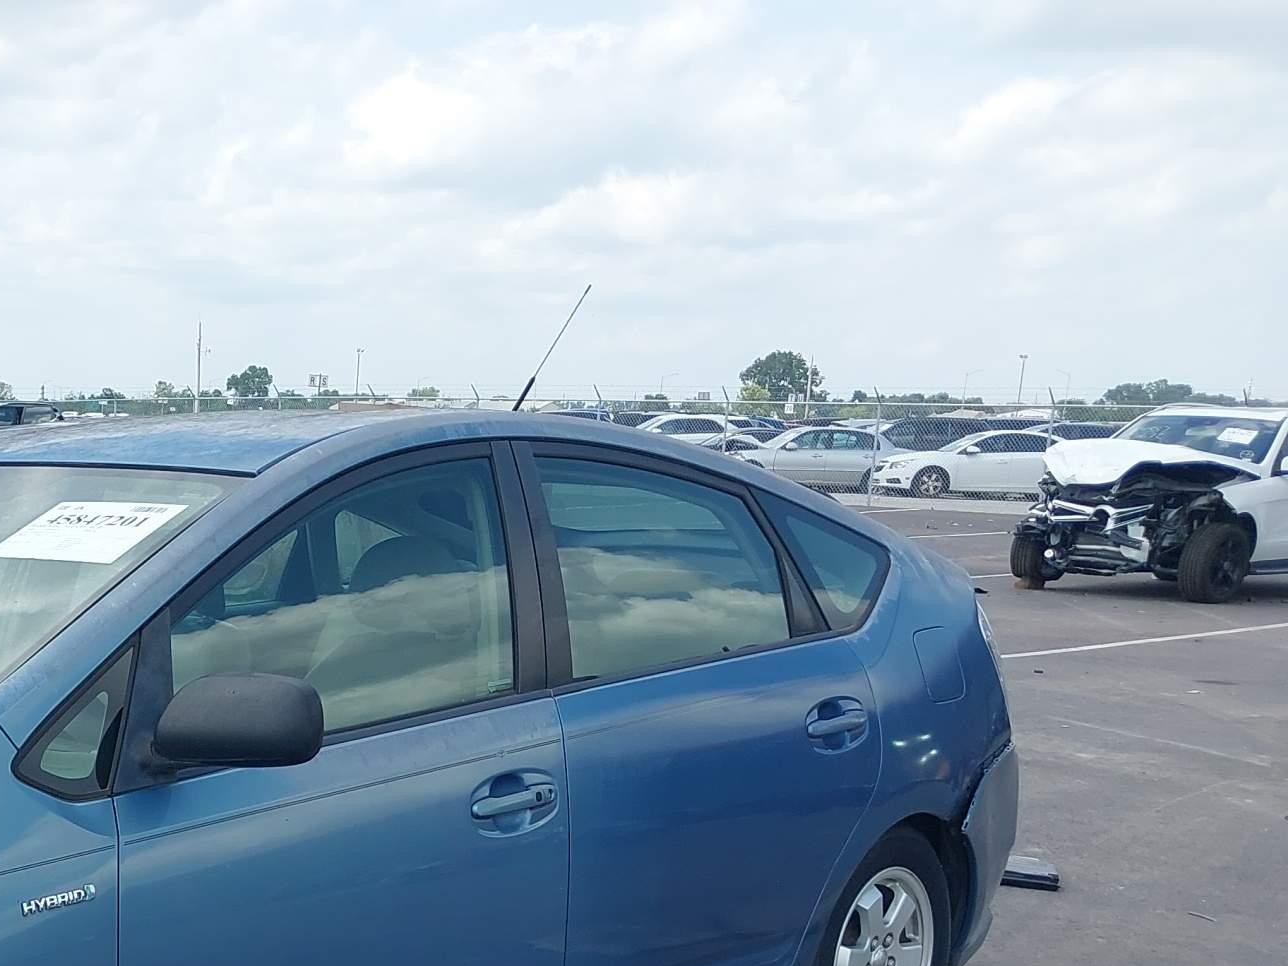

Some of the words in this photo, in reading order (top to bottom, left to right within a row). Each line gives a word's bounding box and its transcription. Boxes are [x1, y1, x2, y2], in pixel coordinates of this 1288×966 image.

[310, 376, 316, 385] R
[322, 377, 328, 386] S
[47, 514, 150, 527] 45847201
[22, 889, 85, 915] HYBRID
